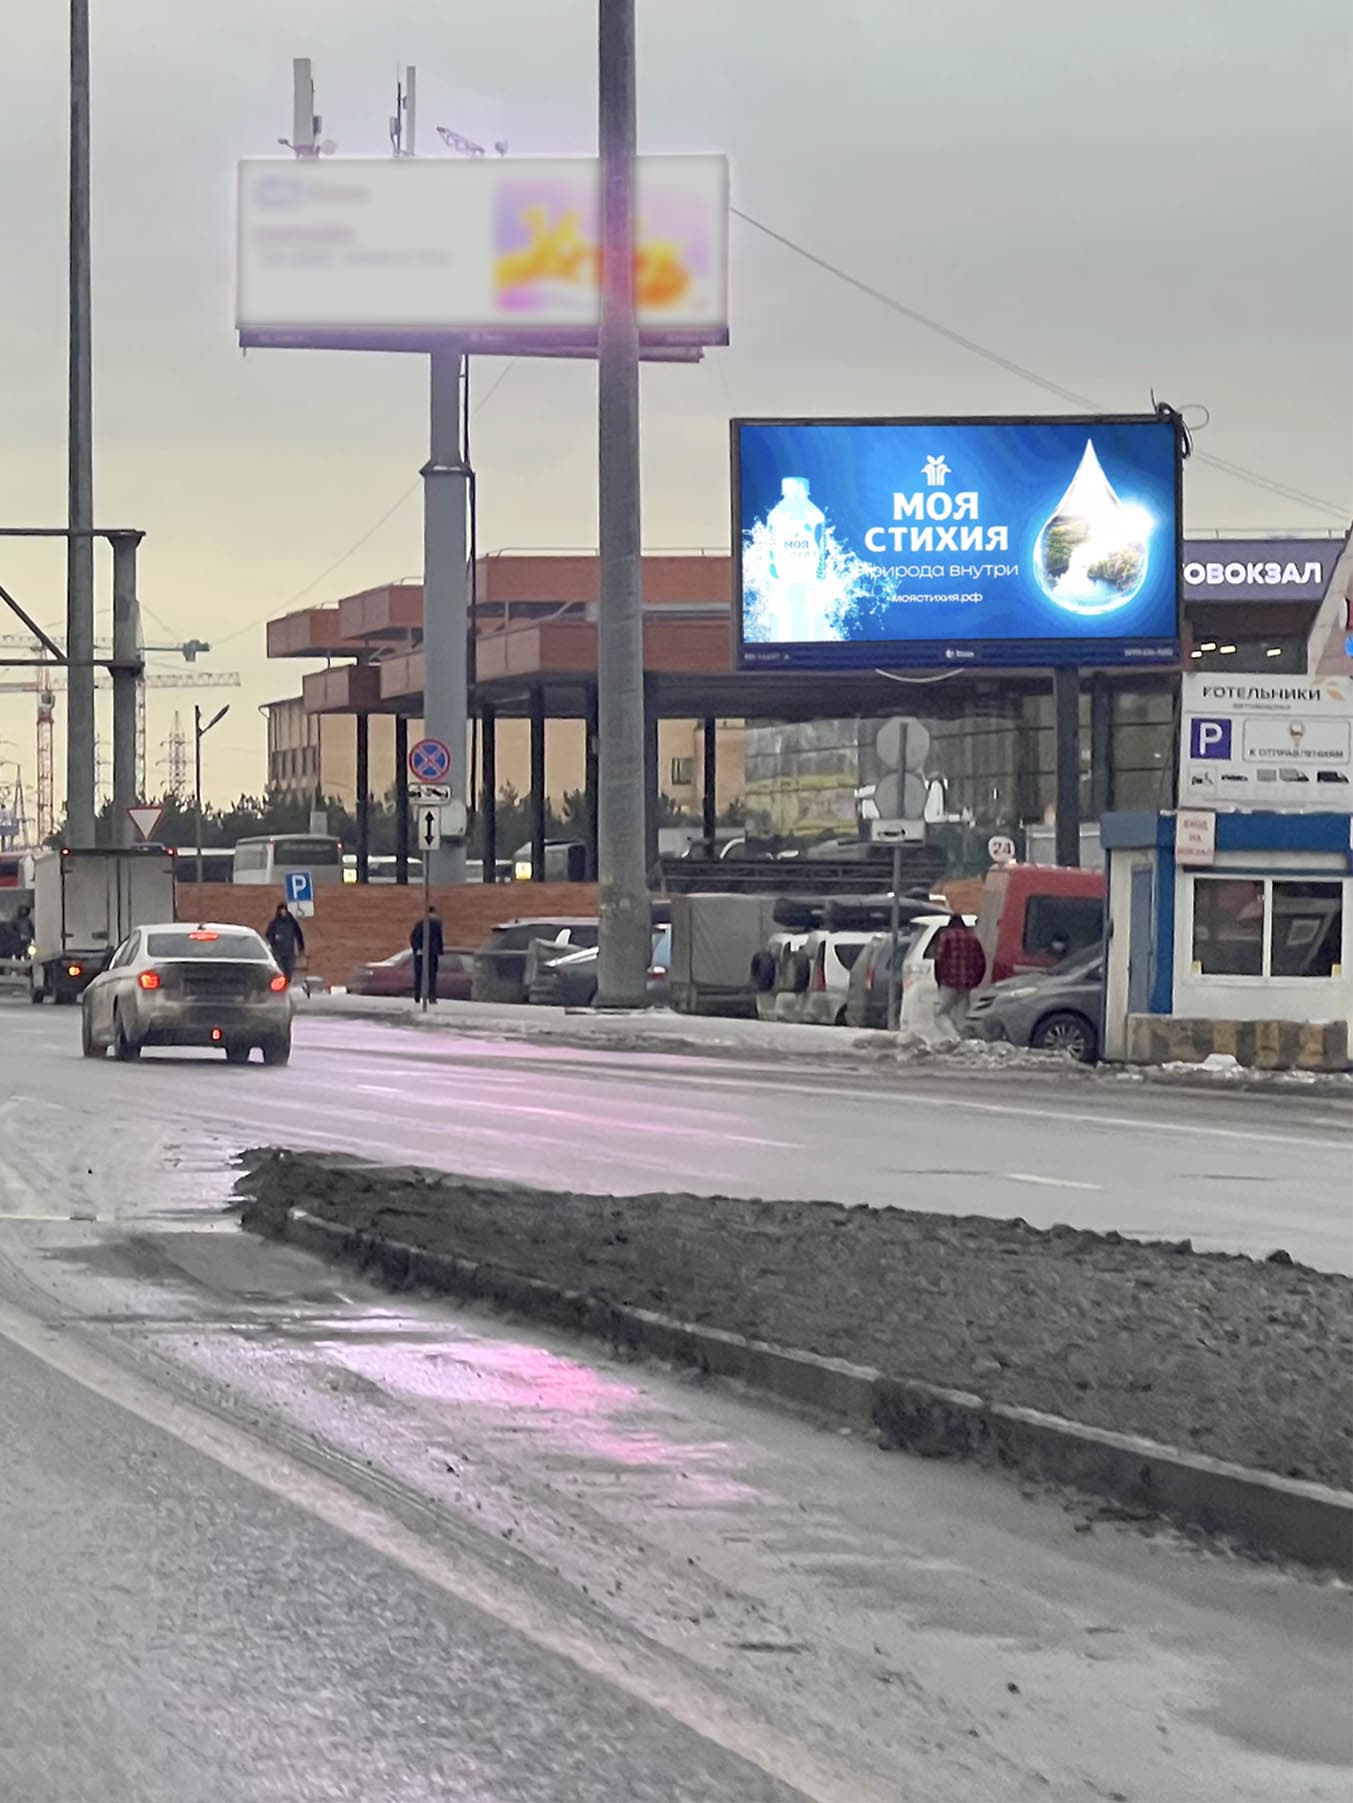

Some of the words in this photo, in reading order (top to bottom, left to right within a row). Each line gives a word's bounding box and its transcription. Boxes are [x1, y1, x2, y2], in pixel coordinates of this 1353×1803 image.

[893, 491, 979, 521] МОЯ
[864, 526, 1009, 552] СТИХИЯ
[949, 564, 1019, 579] внутри
[1183, 562, 1322, 584] ОВОКЗАЛ
